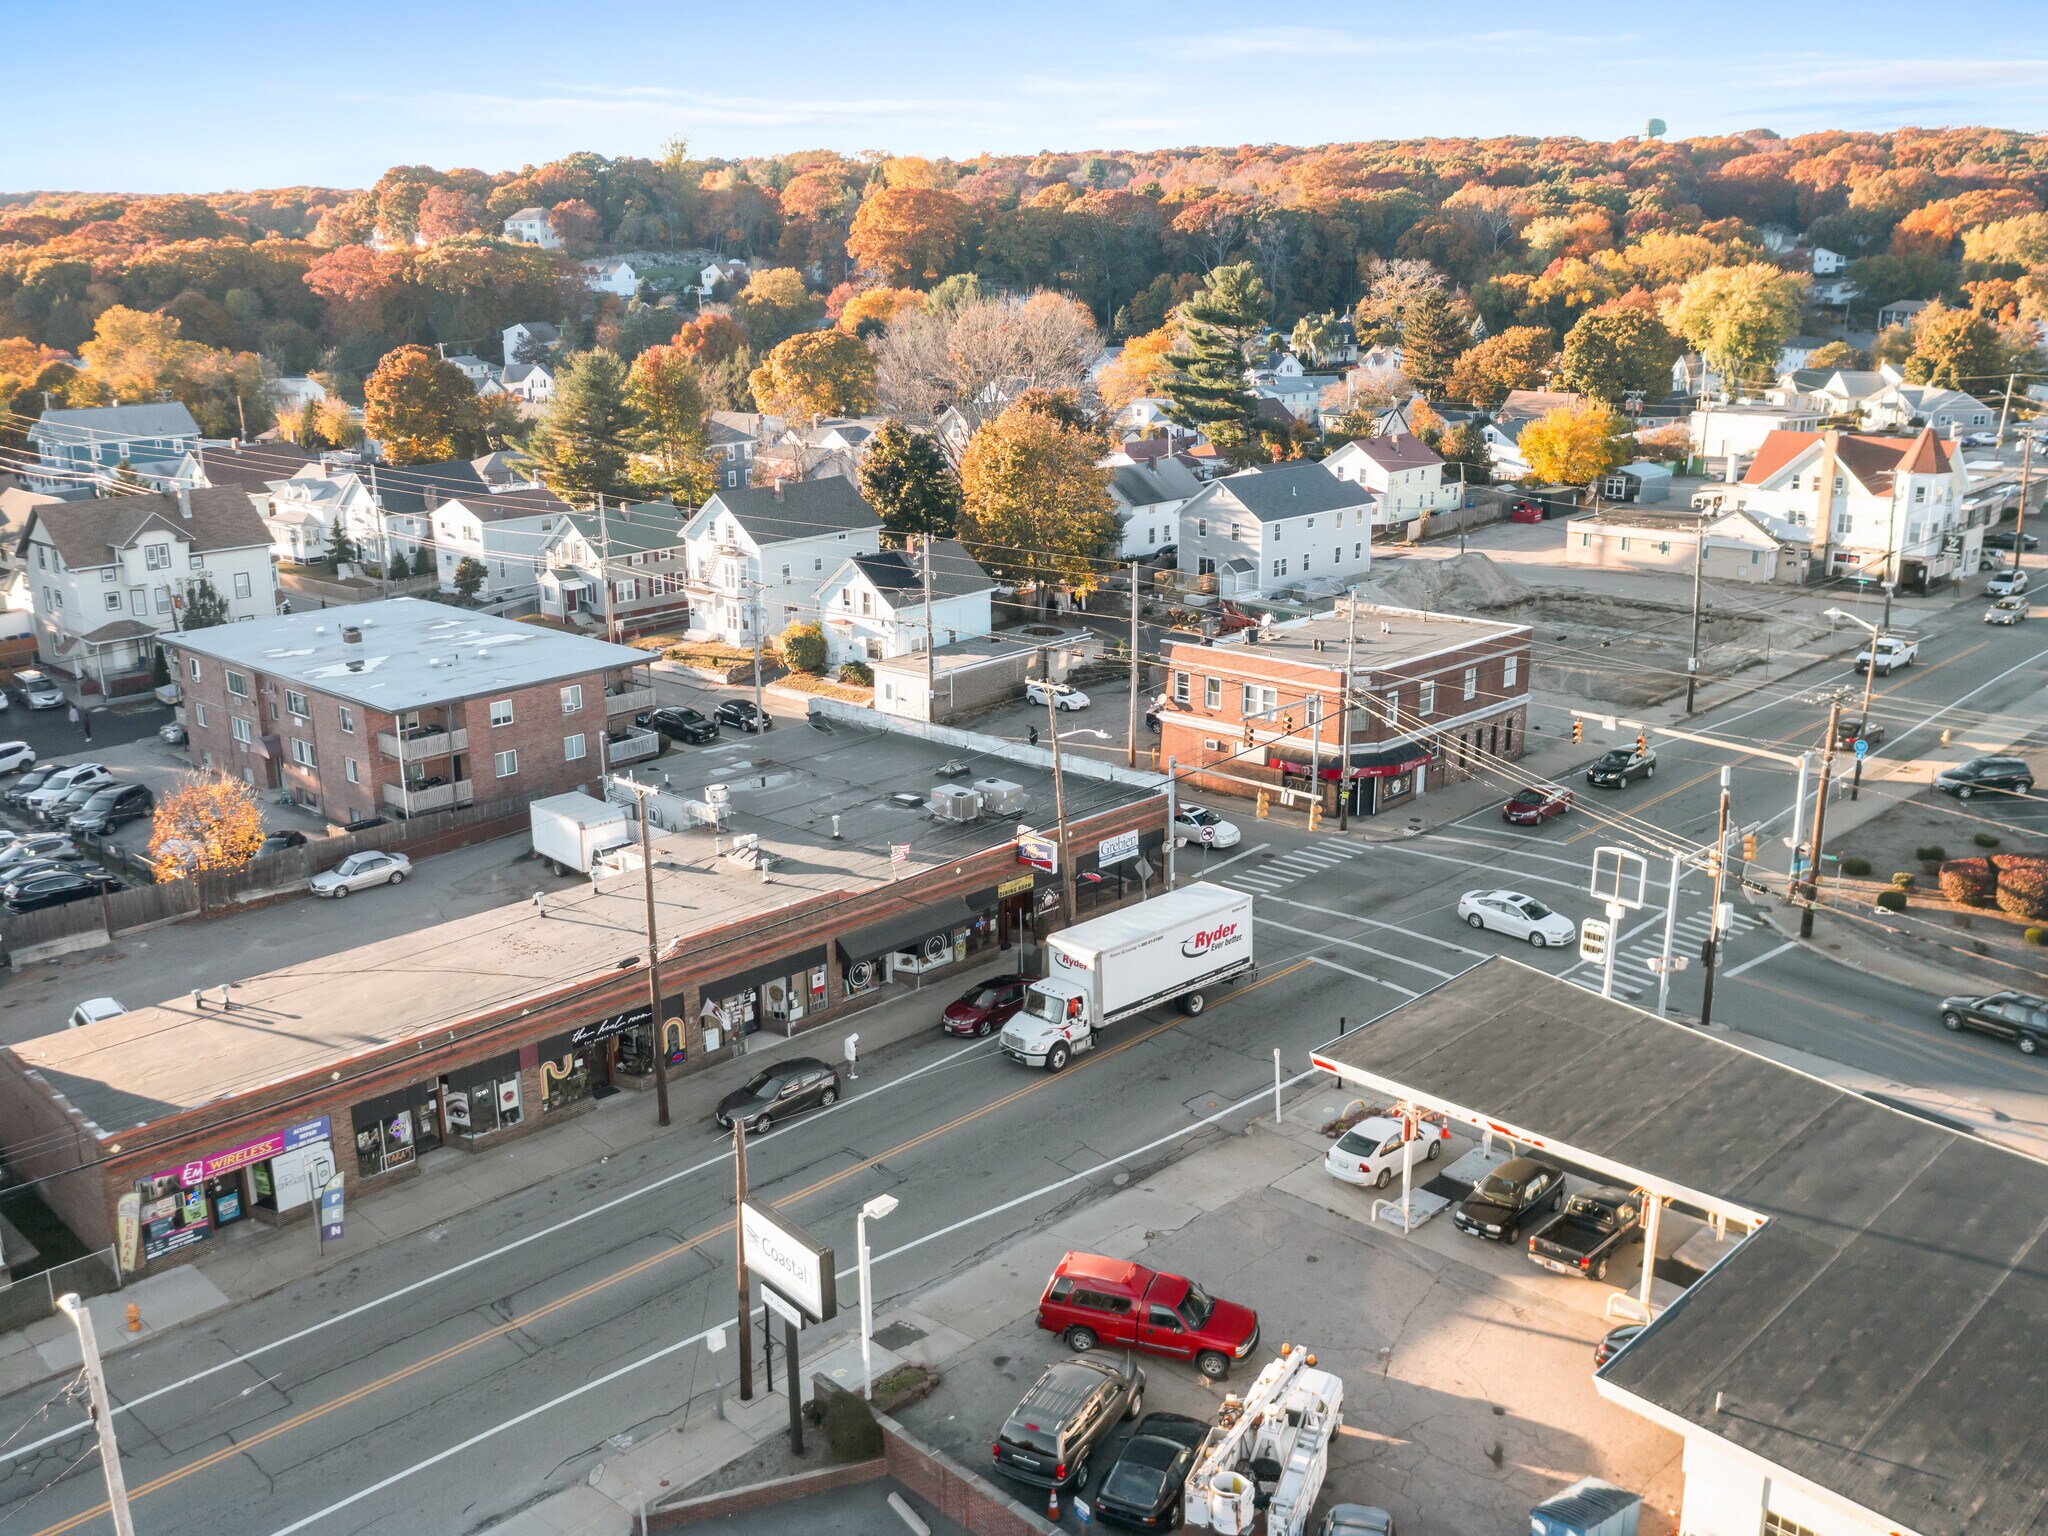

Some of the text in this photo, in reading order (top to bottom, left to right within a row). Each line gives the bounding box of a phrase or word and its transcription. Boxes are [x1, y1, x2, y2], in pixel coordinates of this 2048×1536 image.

[1101, 836, 1136, 855] Grebien
[999, 882, 1032, 898] DINING ROOM
[1194, 922, 1238, 949] Ryder
[1211, 934, 1243, 952] Ever better
[1062, 954, 1088, 970] Ryder
[572, 1012, 653, 1043] the heal room
[594, 1034, 609, 1043] people
[389, 1122, 406, 1133] OPEN
[210, 1142, 273, 1170] WIRELESS
[331, 1178, 341, 1236] OPEN
[123, 1216, 133, 1265] REPAIR
